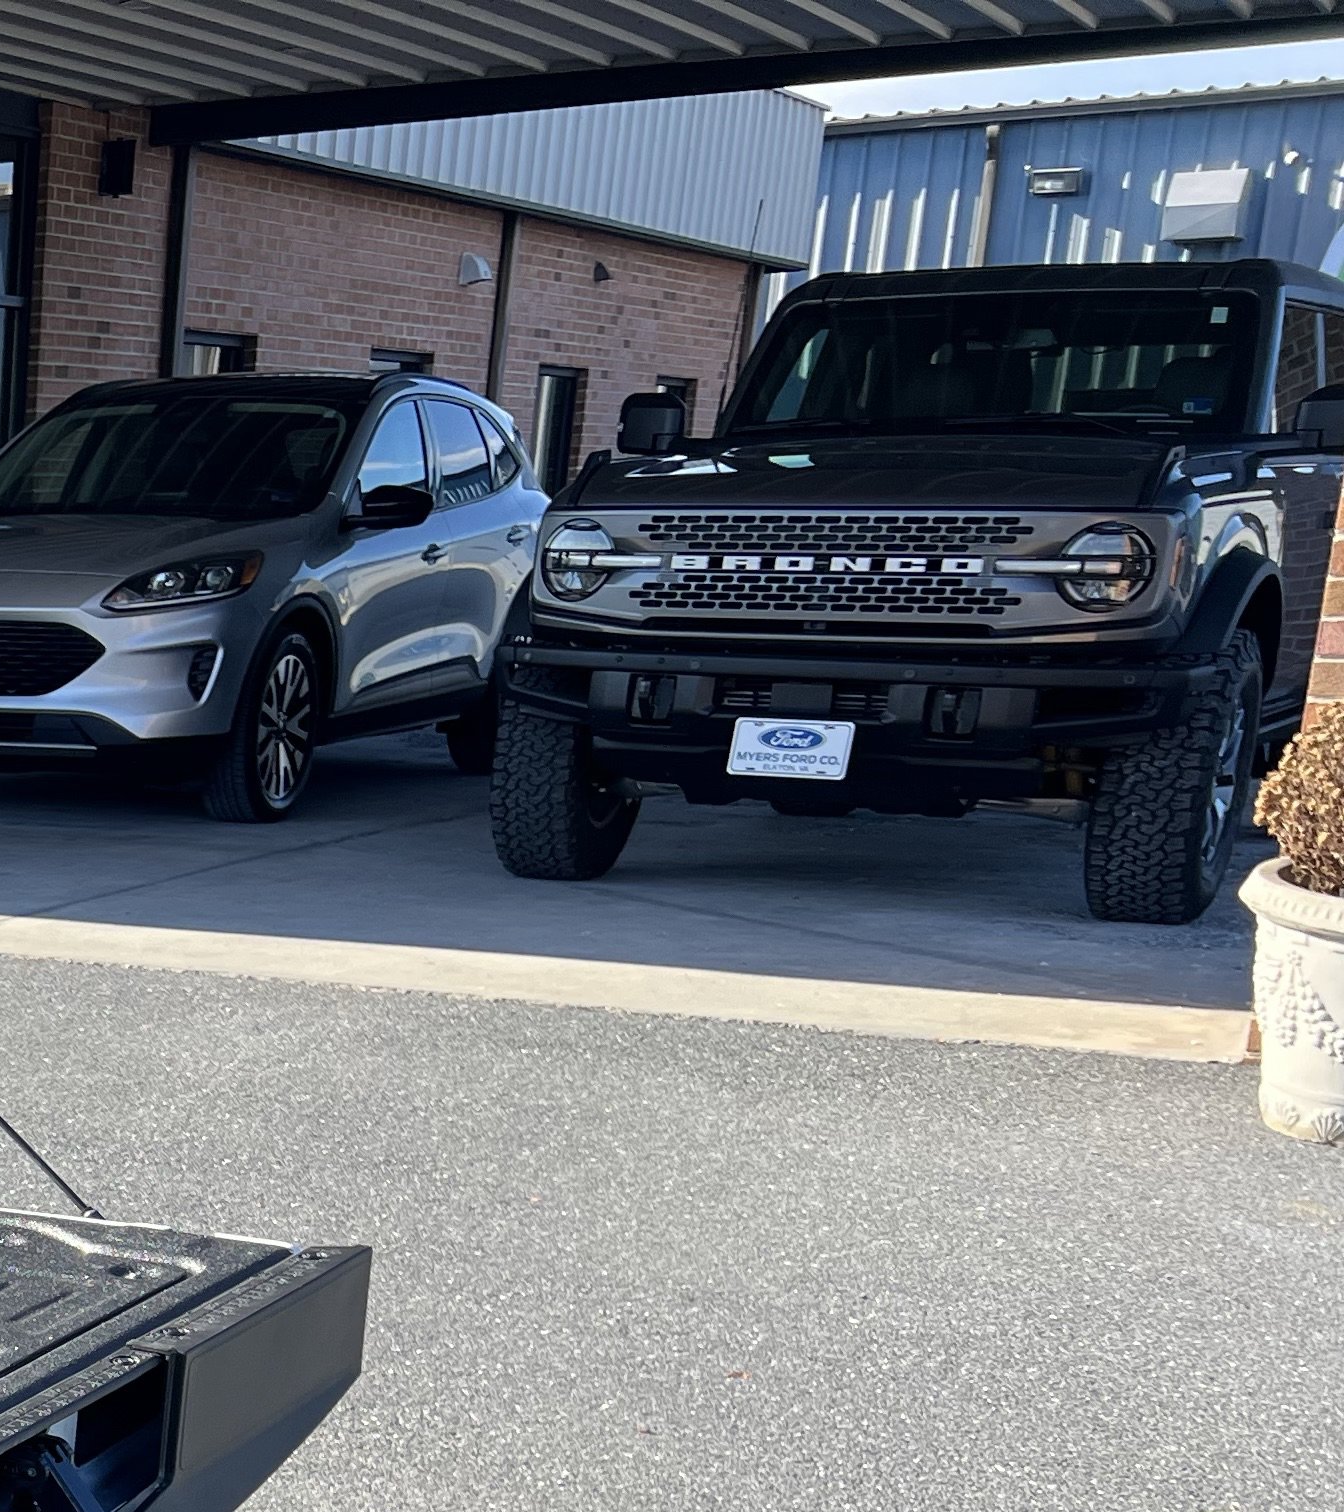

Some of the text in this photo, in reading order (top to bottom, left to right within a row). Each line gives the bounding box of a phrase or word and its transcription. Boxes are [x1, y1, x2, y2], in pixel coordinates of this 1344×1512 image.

[670, 555, 985, 574] BRONCO
[737, 751, 841, 766] MYERS FORD CO.
